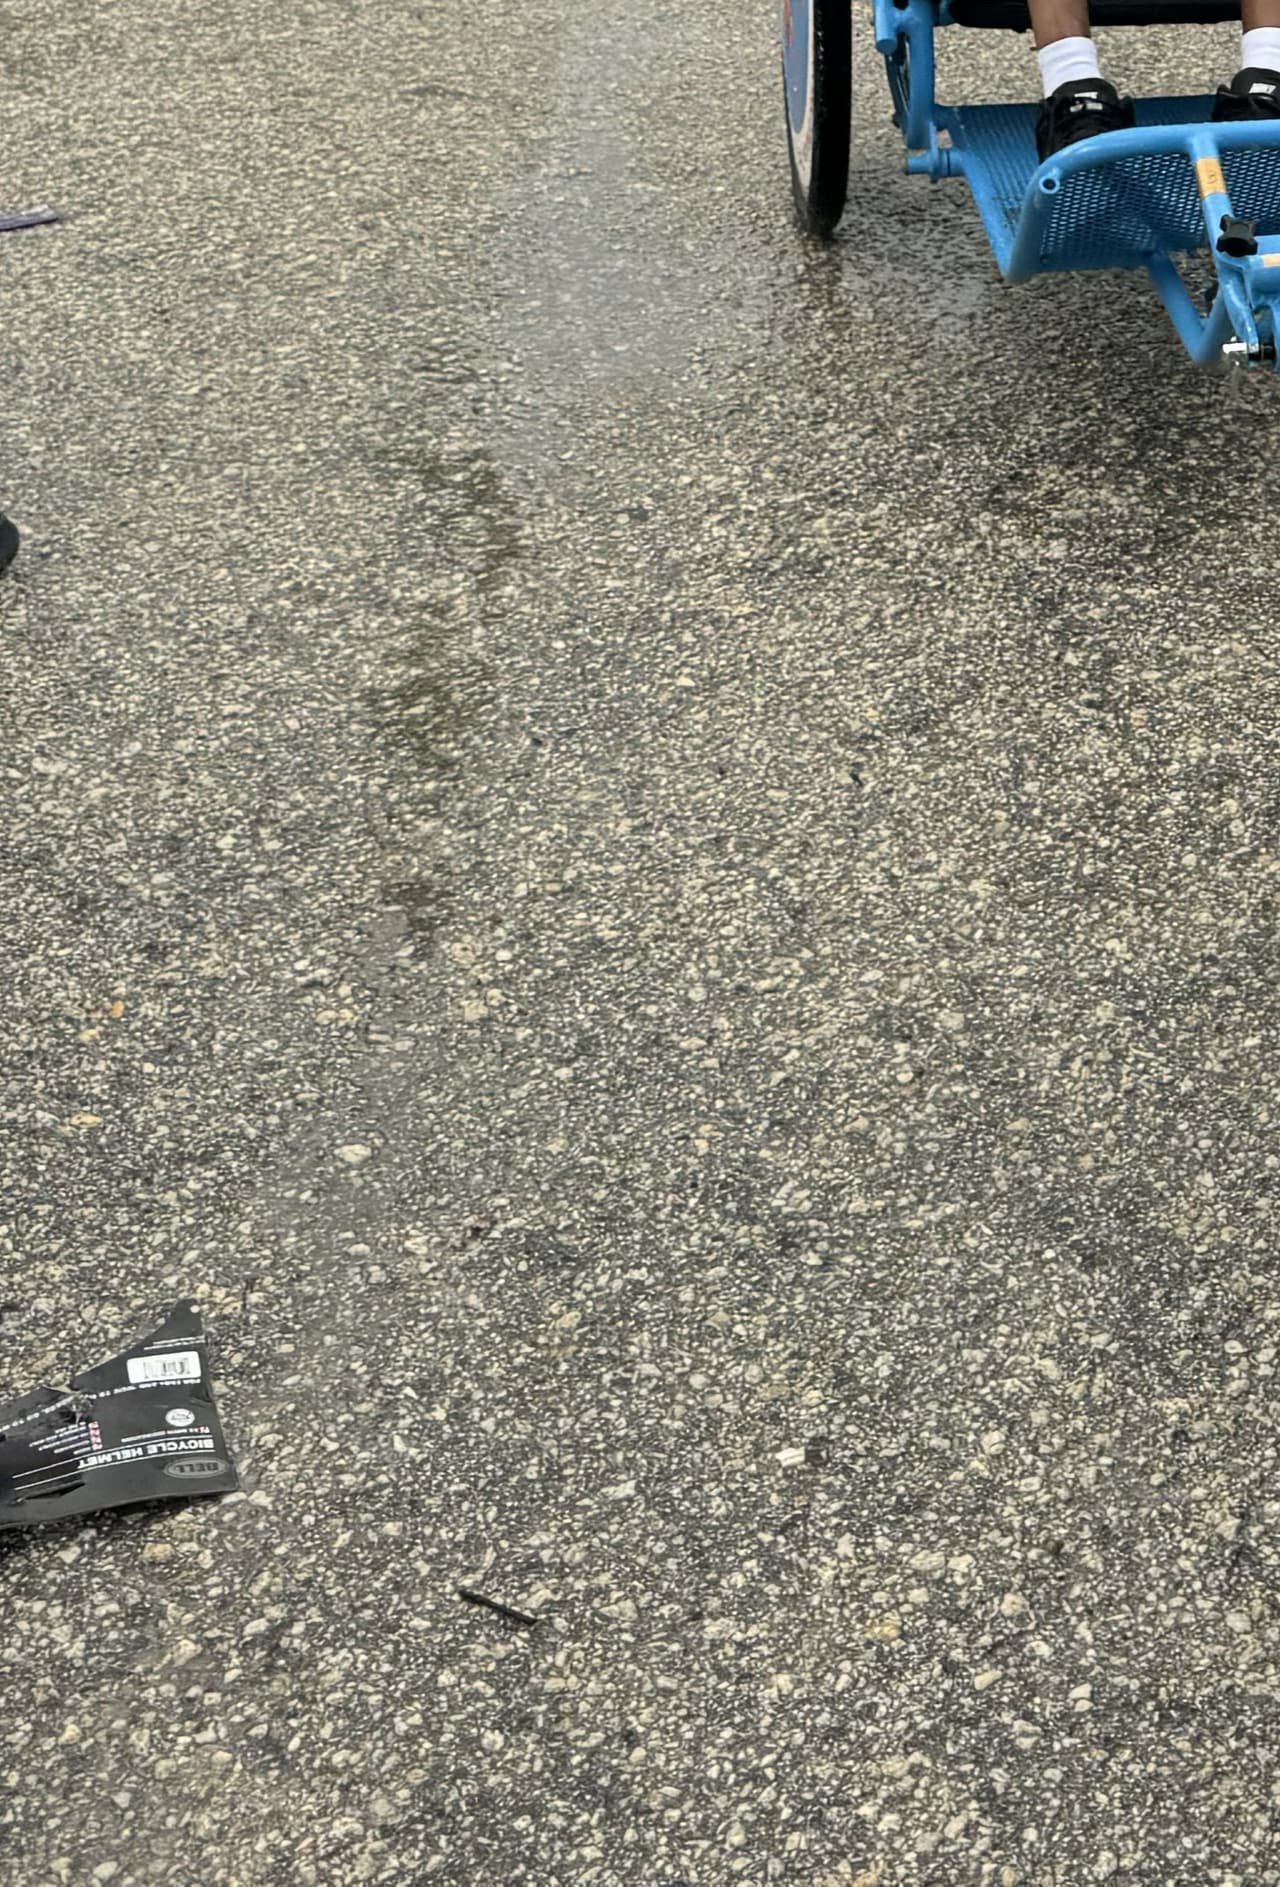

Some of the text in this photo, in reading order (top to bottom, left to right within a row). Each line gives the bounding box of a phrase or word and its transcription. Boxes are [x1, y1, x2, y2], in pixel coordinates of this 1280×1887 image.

[78, 1438, 215, 1470] BICYCLE HELMET
[174, 1462, 220, 1475] BELL
